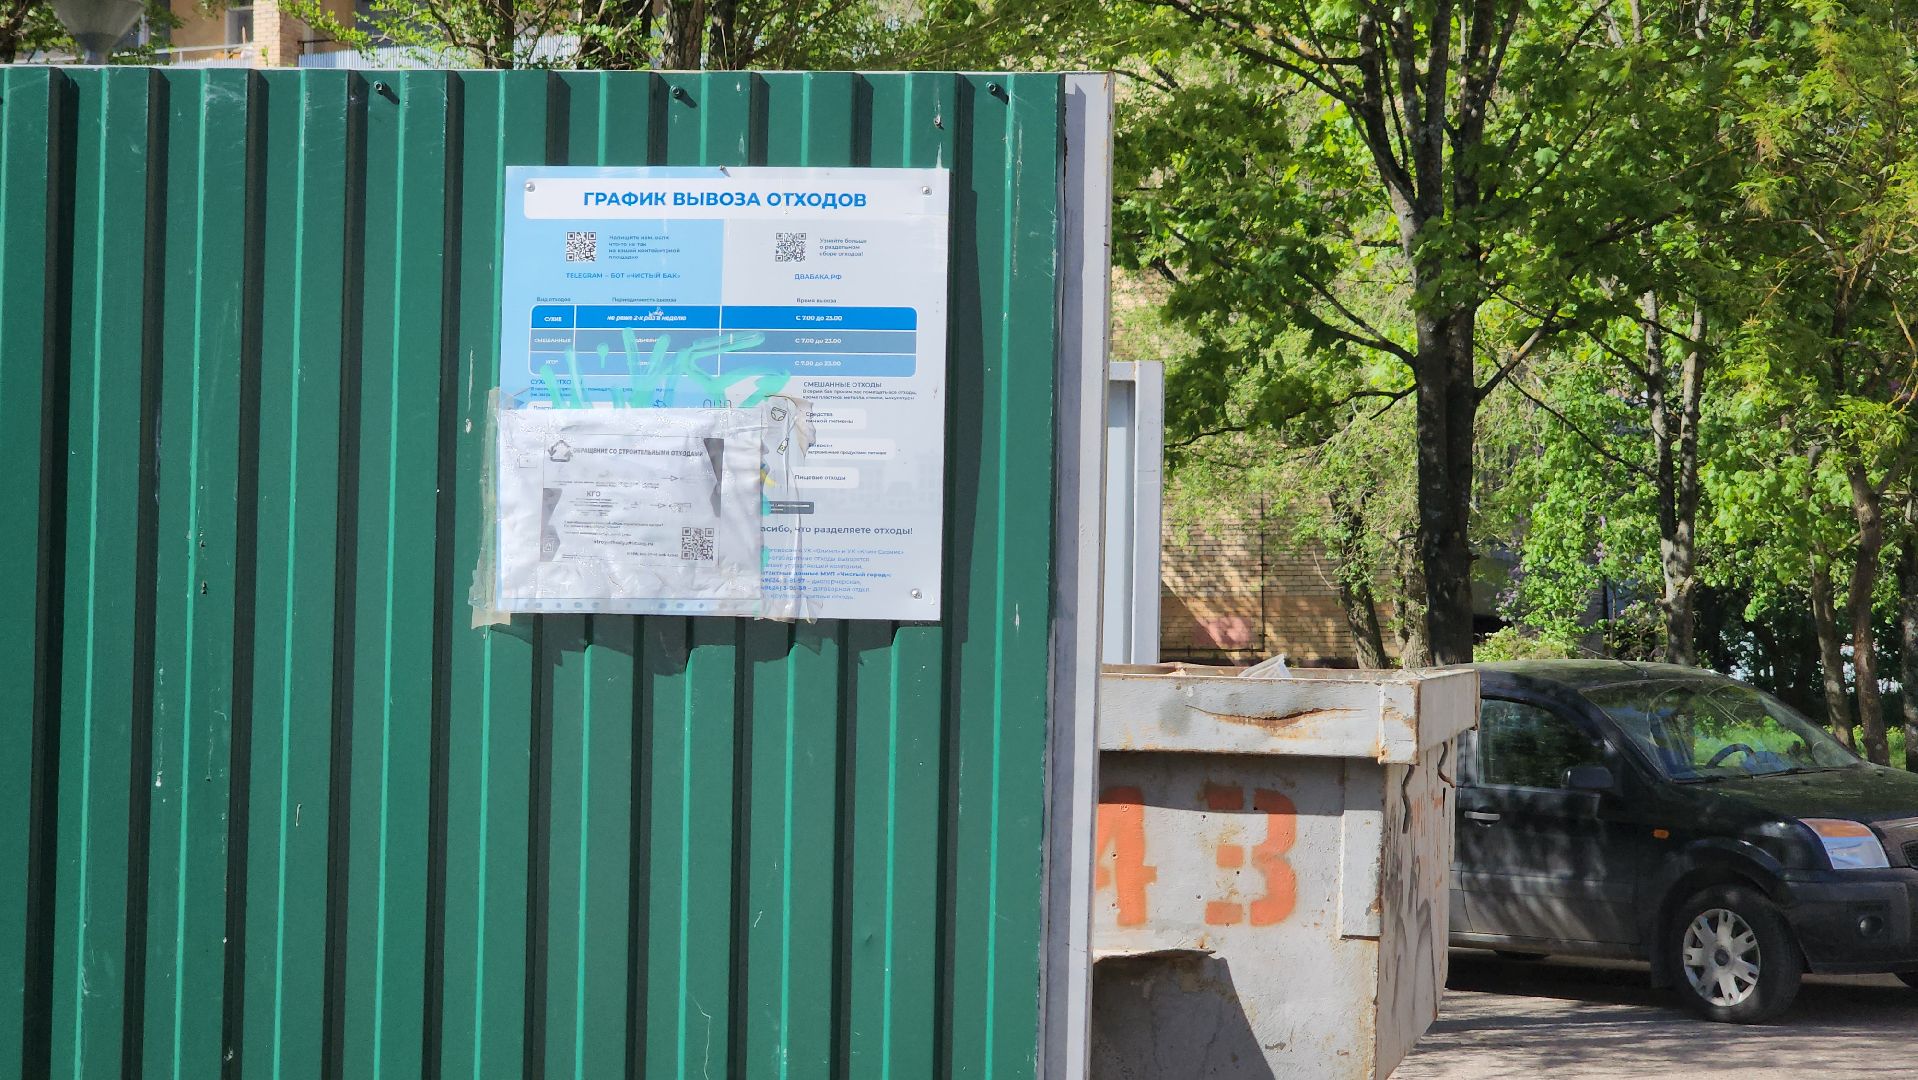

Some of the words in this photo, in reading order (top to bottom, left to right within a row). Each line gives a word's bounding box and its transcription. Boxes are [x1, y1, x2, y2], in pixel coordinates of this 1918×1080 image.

[584, 192, 666, 206] ГРАФИК
[673, 192, 760, 206] ВЫВОЗА
[767, 192, 867, 209] ОТХОДОВ
[761, 525, 792, 534] асибо,
[874, 527, 913, 536] отходы!
